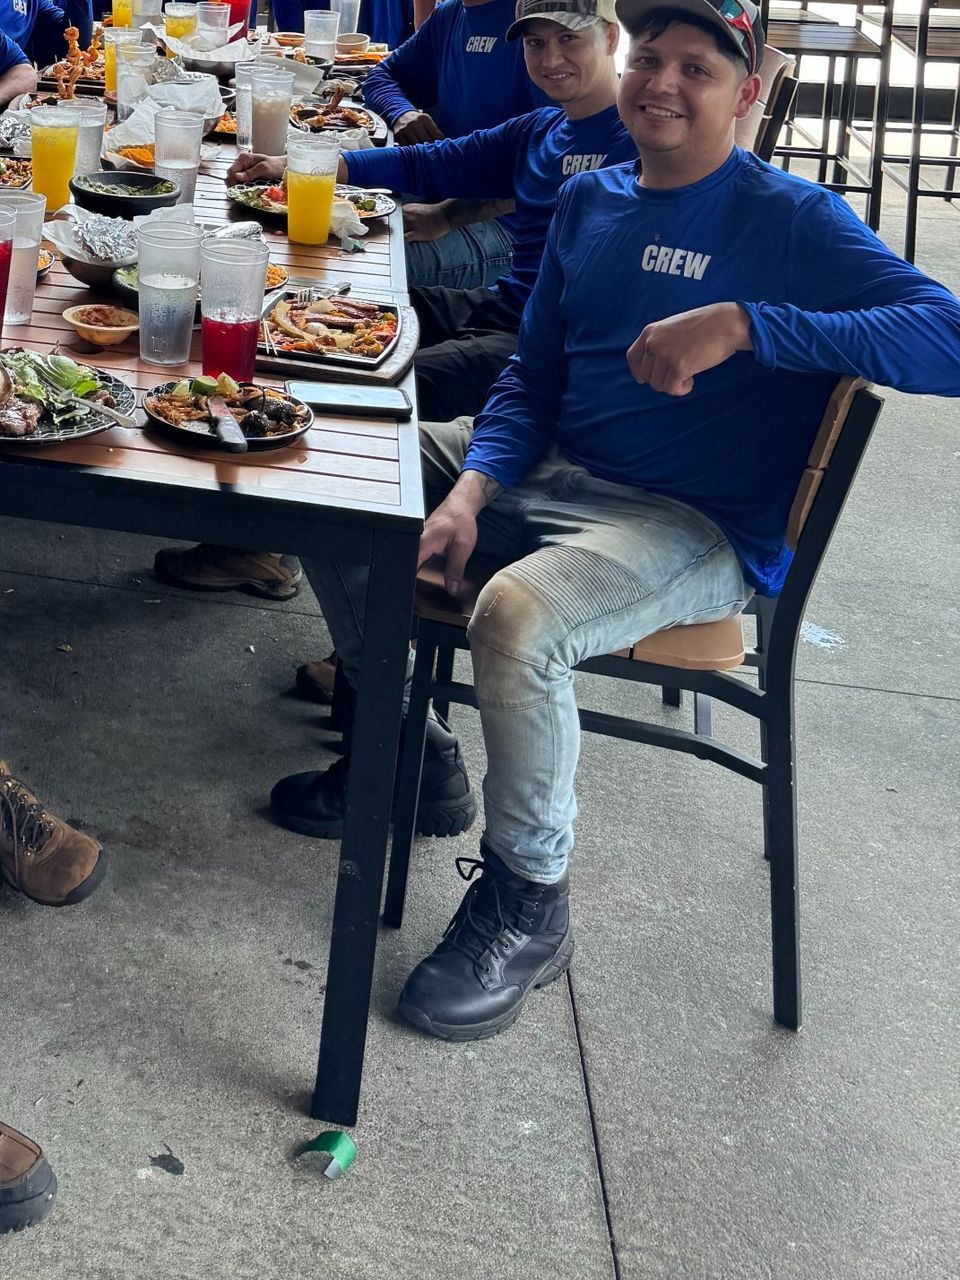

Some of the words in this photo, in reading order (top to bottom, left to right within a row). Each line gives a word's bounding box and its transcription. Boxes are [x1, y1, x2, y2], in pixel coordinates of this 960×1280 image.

[466, 36, 498, 53] CREW
[562, 154, 608, 176] CREW
[641, 244, 712, 281] CREW
